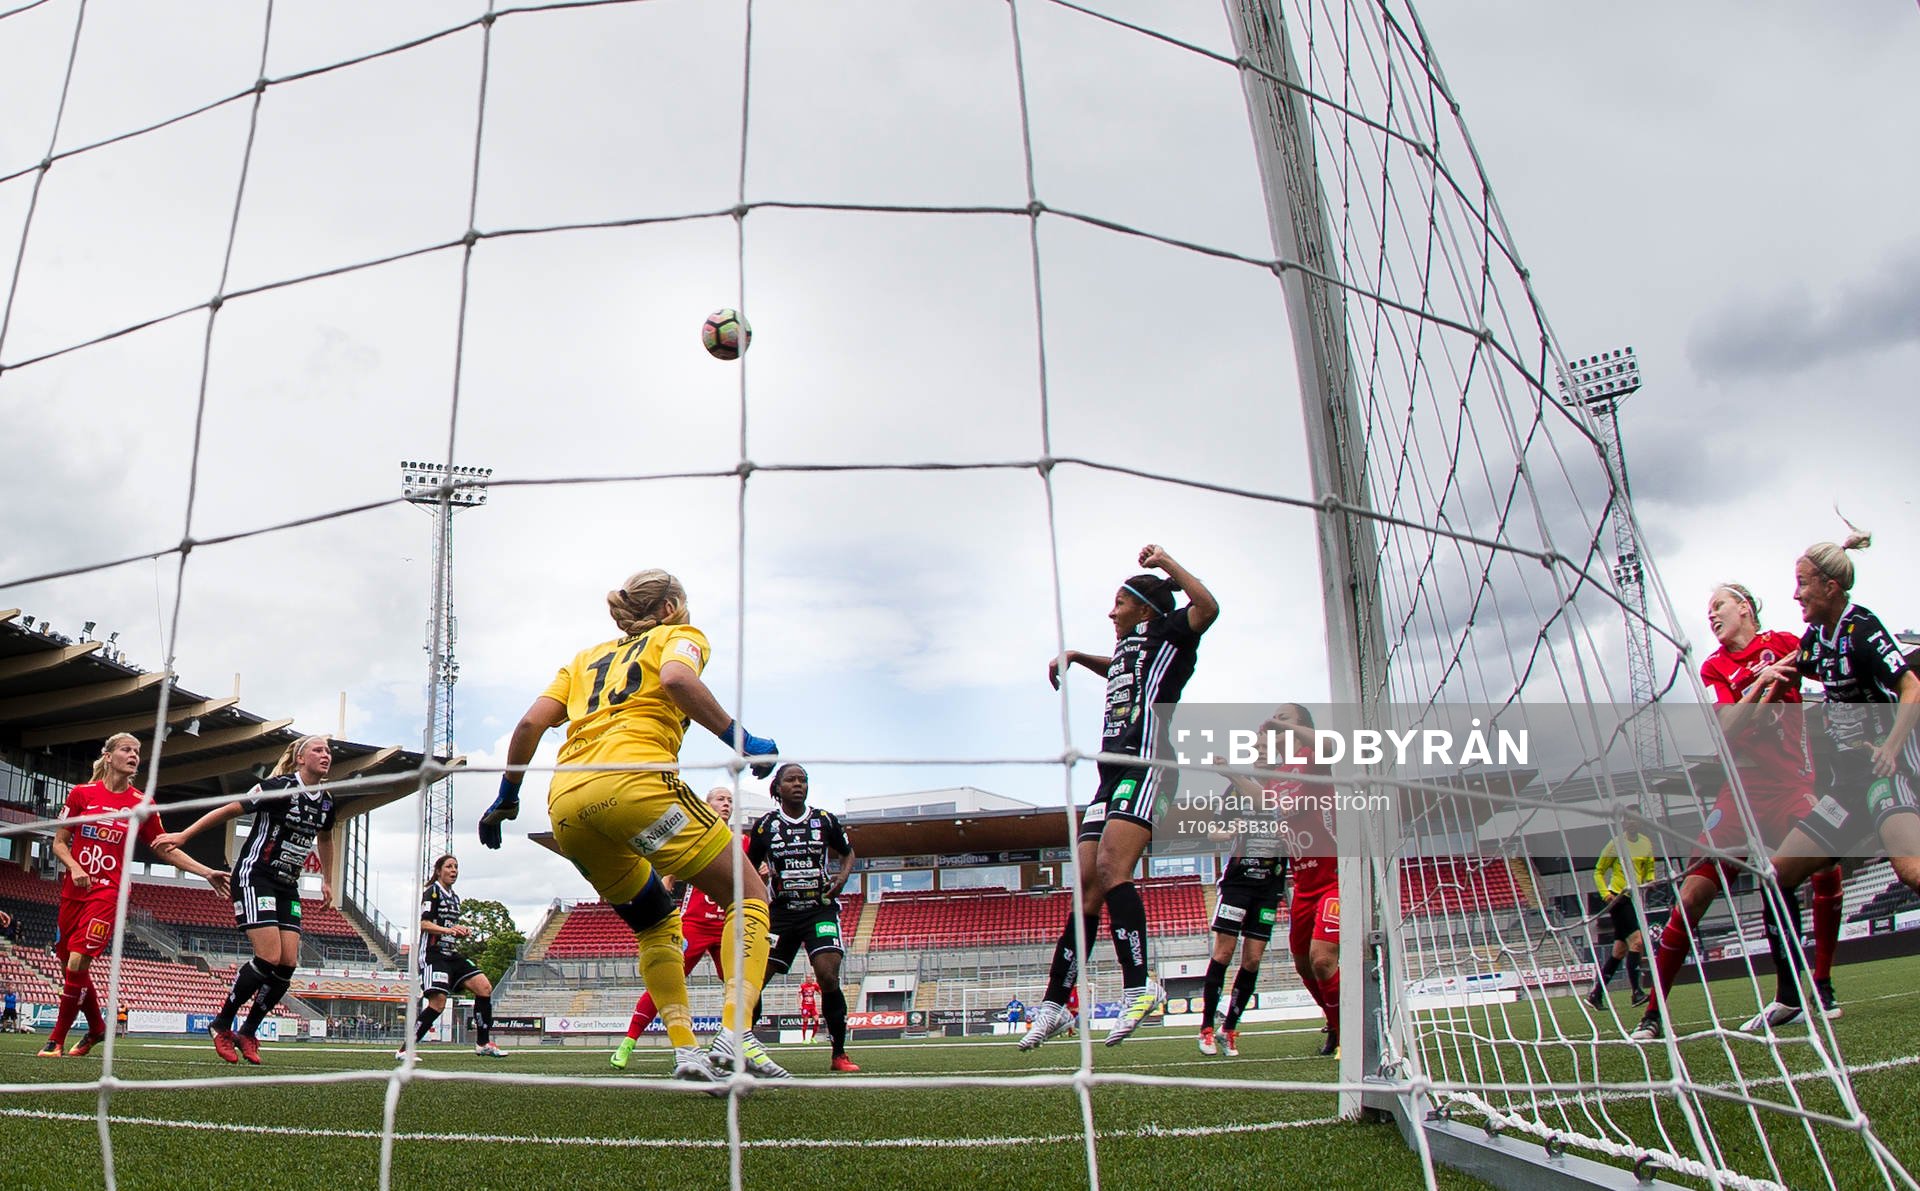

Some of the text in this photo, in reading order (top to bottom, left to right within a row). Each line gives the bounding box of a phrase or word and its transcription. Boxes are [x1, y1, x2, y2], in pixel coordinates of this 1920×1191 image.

[577, 797, 618, 821] KAIDING
[1119, 799, 1128, 811] 9
[81, 824, 124, 844] ELON
[79, 844, 117, 875] ÖBO
[784, 856, 813, 869] Piteå
[593, 1020, 625, 1028] Thornton
[691, 1022, 722, 1031] KPMG
